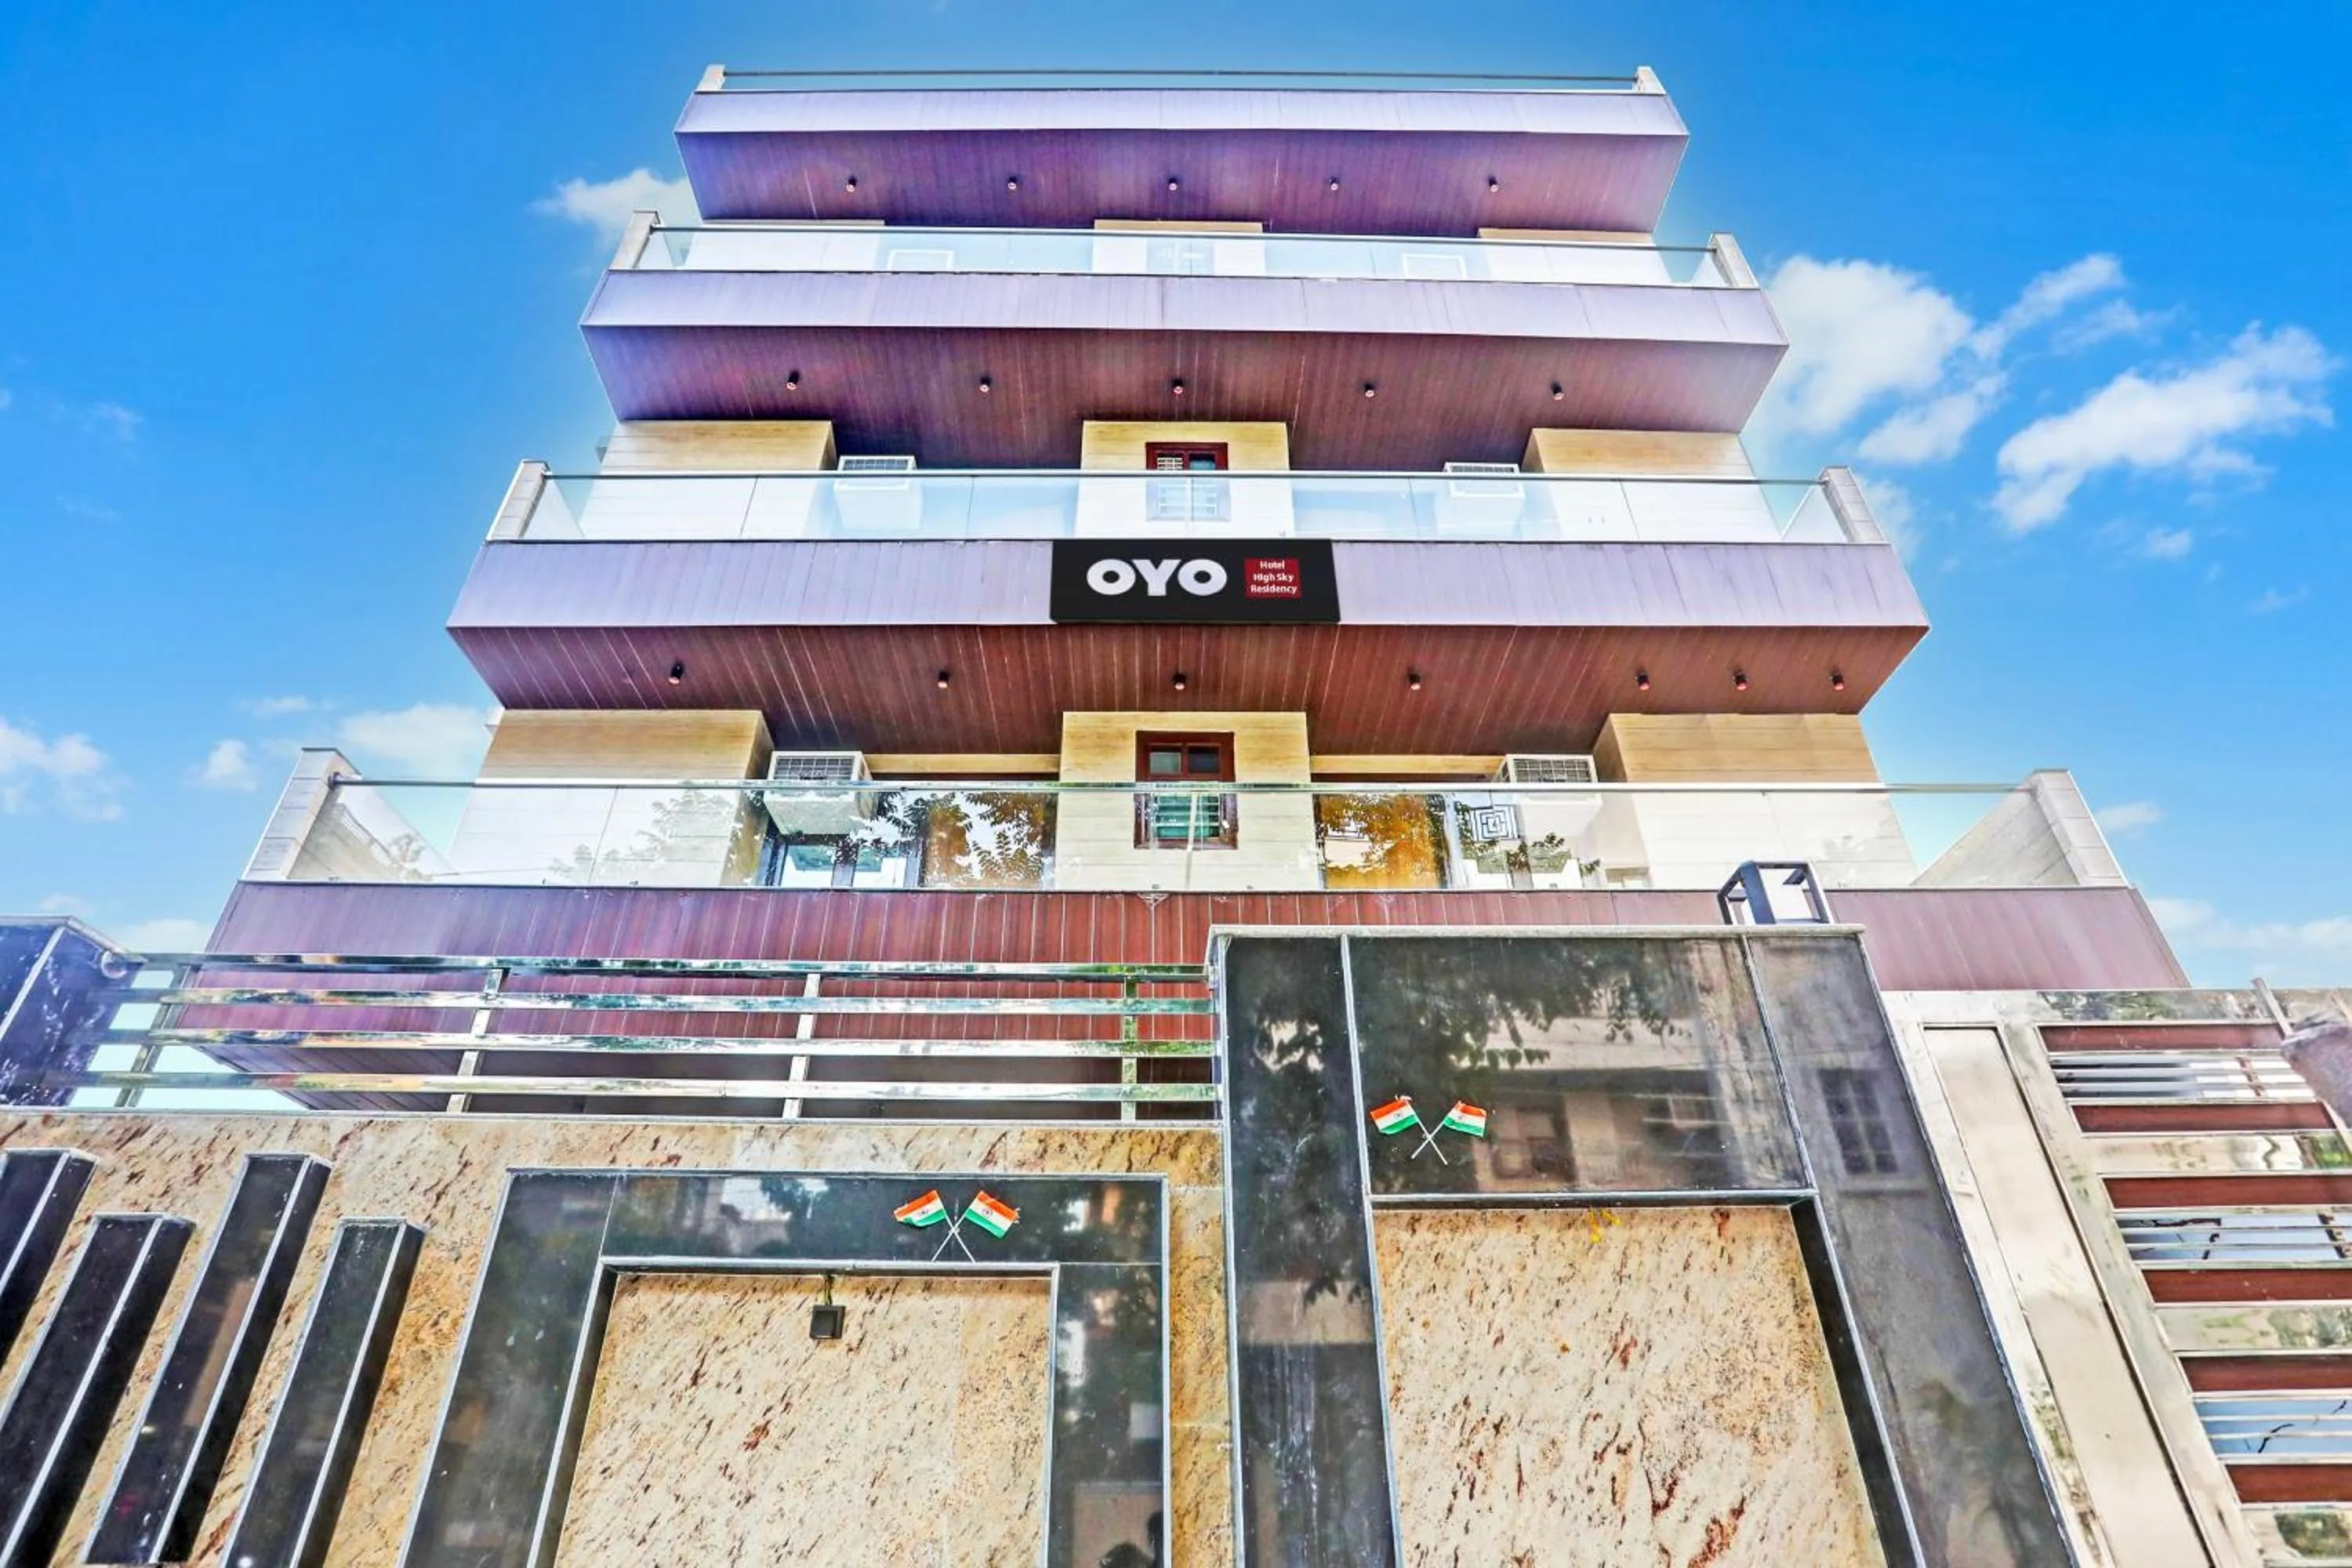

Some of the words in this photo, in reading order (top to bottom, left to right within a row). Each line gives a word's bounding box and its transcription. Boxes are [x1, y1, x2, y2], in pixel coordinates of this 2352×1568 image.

[1260, 560, 1285, 569] Hotel
[1087, 558, 1227, 597] OYO
[1254, 573, 1276, 583] High
[1276, 572, 1294, 583] Sky
[1250, 584, 1298, 595] Residency
